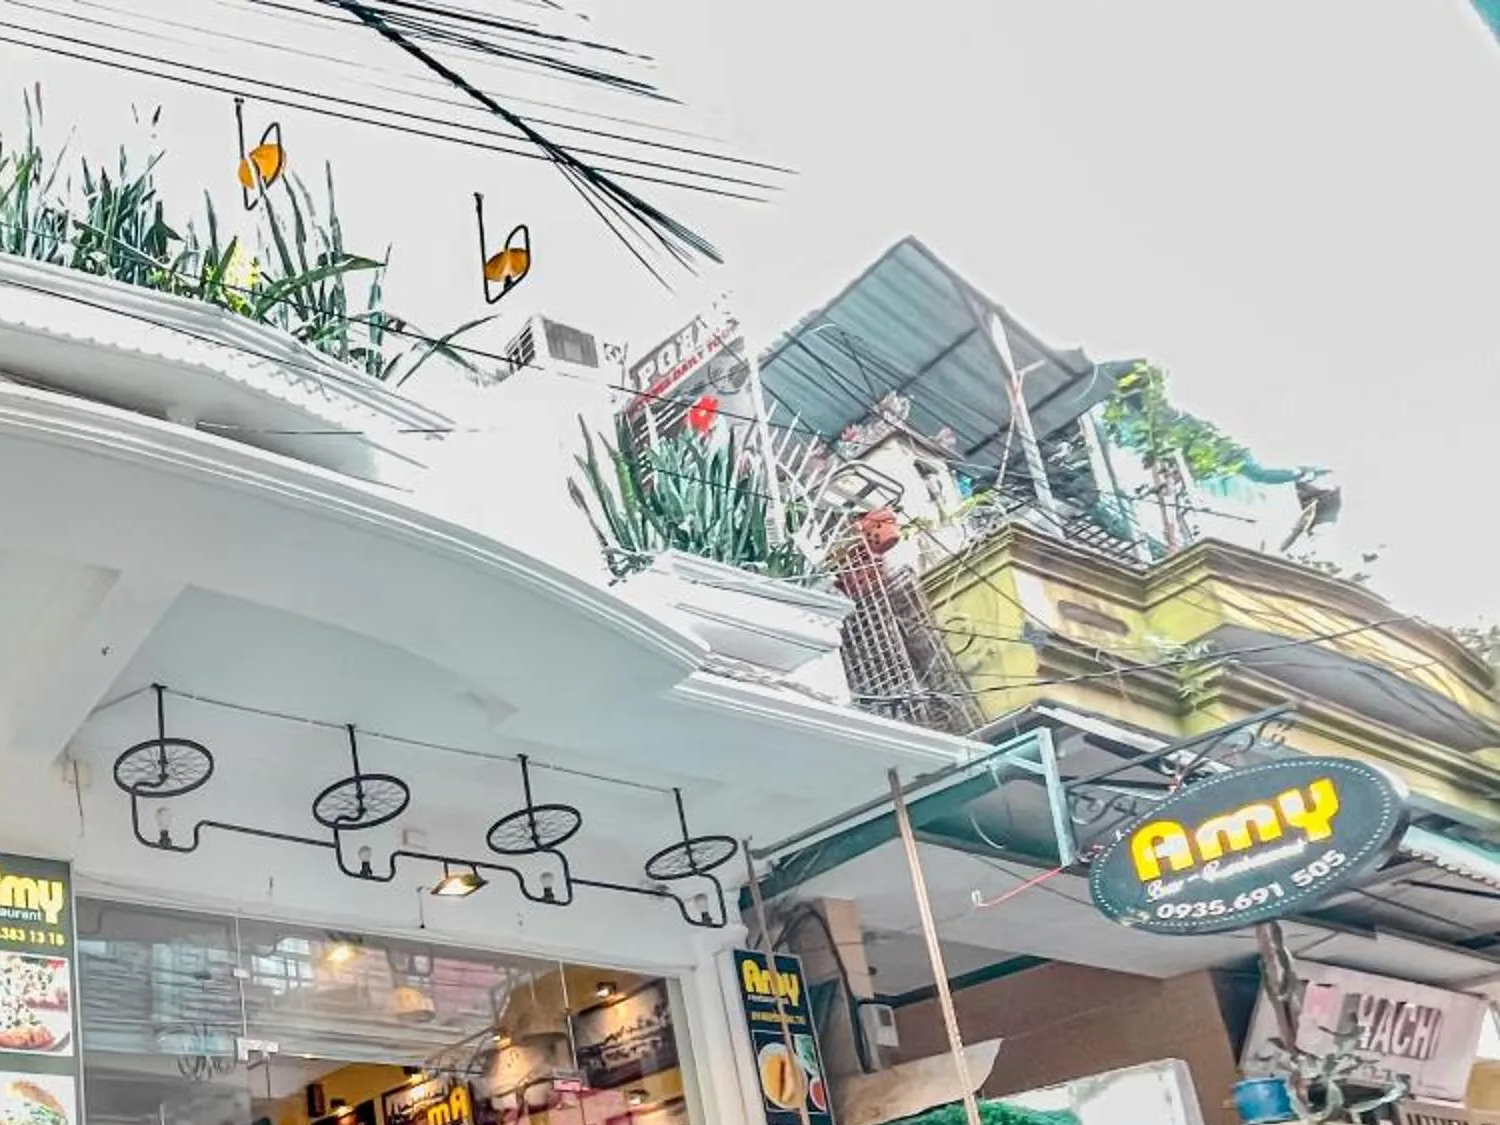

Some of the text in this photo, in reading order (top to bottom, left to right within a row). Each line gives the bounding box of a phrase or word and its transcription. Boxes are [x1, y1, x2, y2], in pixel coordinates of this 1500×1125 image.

[1131, 777, 1339, 882] Amy
[1156, 849, 1347, 919] 0935.691 505
